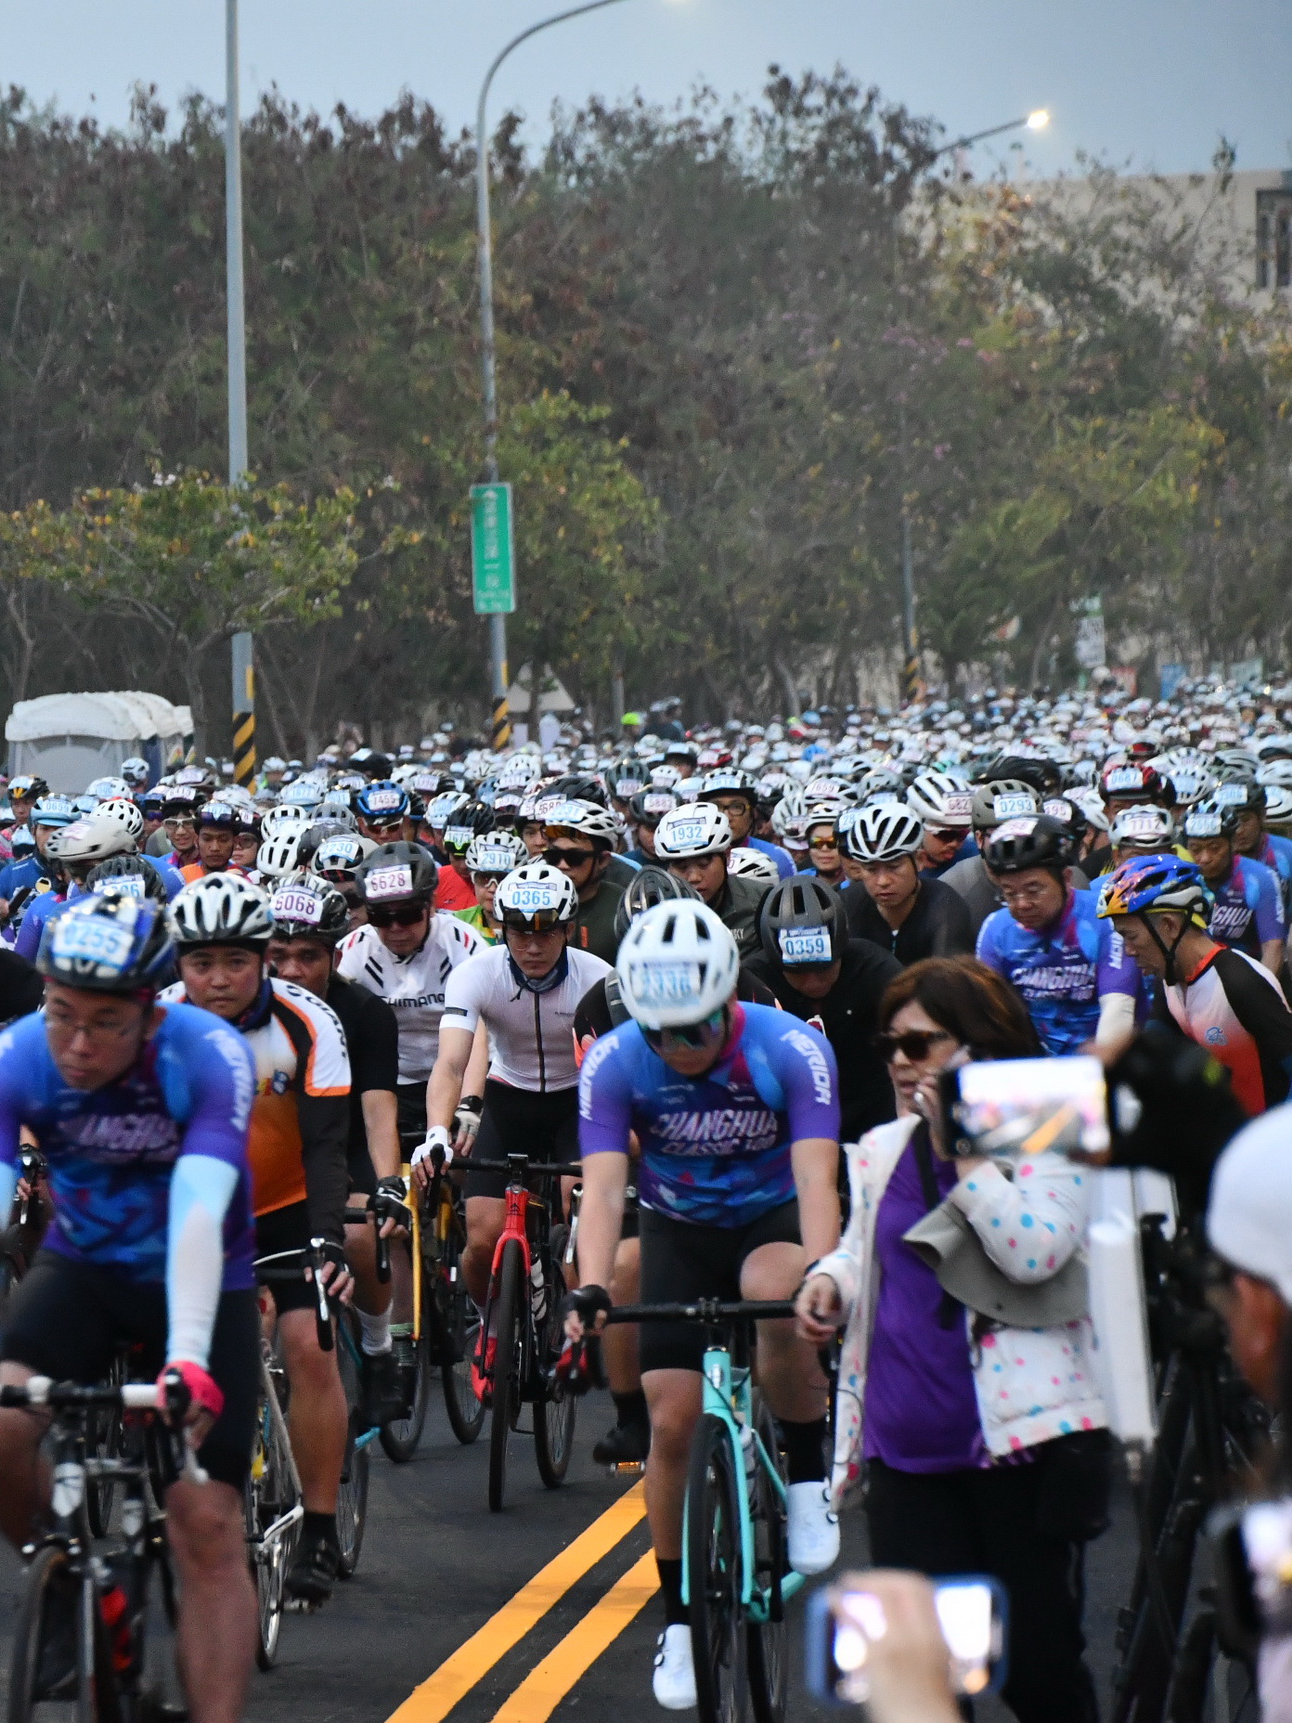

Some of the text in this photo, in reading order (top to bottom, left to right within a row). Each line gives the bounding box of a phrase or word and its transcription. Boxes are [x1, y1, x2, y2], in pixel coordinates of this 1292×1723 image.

[999, 803, 1033, 814] 0293
[672, 826, 704, 842] 1932
[371, 873, 405, 891] 6628
[512, 890, 551, 906] 0365
[784, 937, 826, 955] 0359
[780, 1029, 832, 1107] MERIDA
